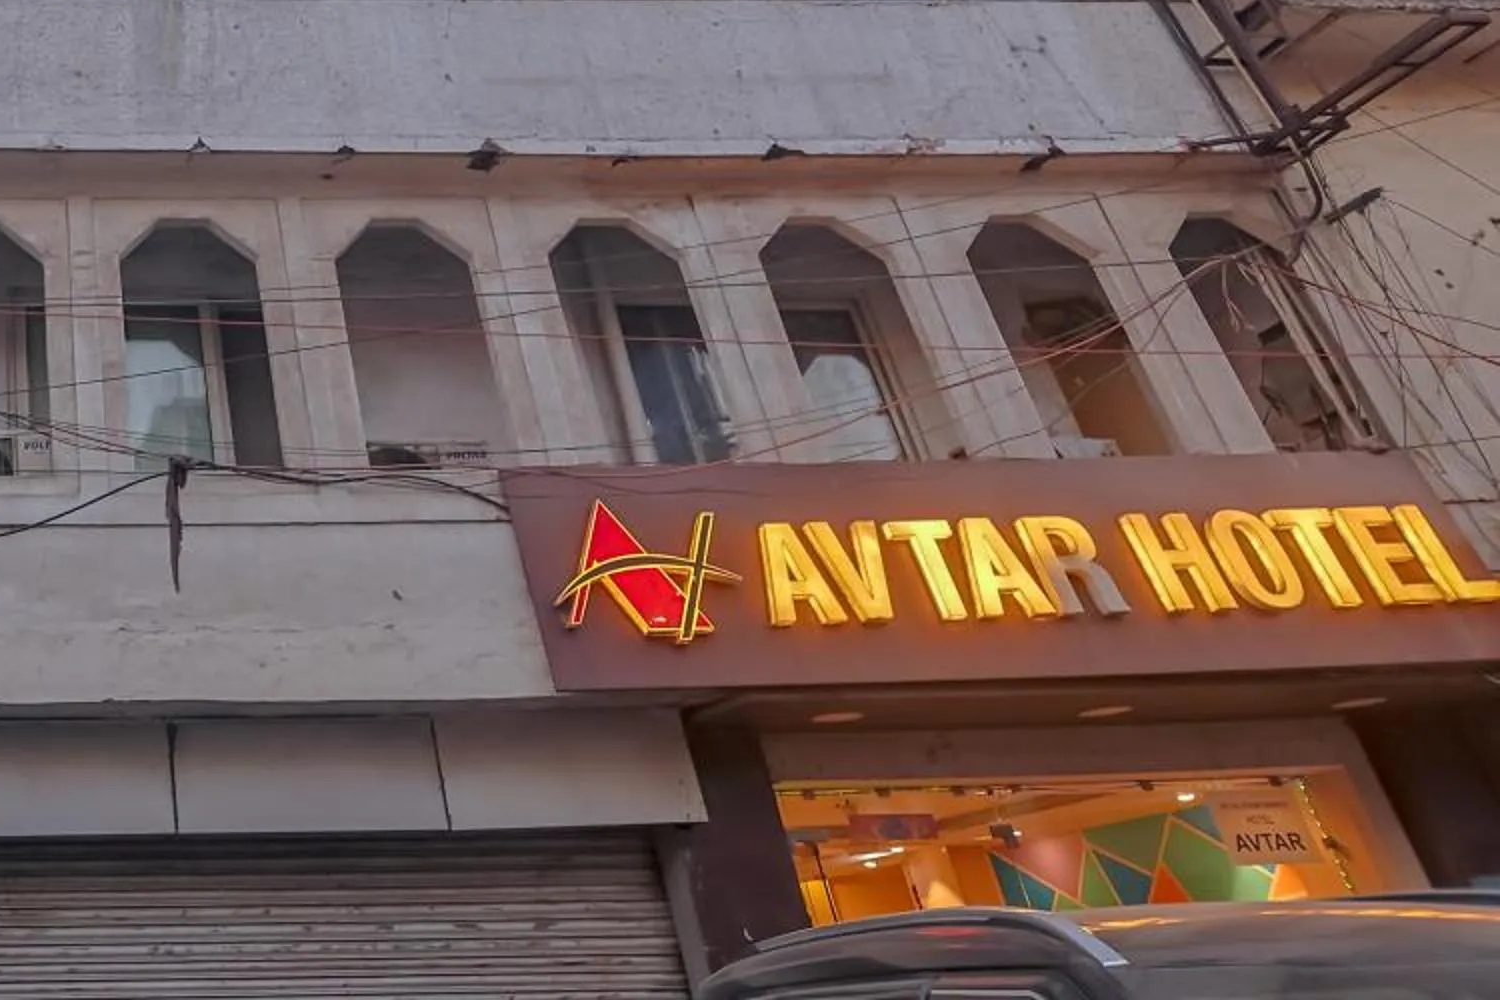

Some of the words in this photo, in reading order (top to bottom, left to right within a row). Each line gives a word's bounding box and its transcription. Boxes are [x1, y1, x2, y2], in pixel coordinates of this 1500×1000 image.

[758, 515, 1131, 627] AVTAR
[1118, 503, 1500, 614] HOTEL
[1236, 831, 1307, 852] AVTAR
